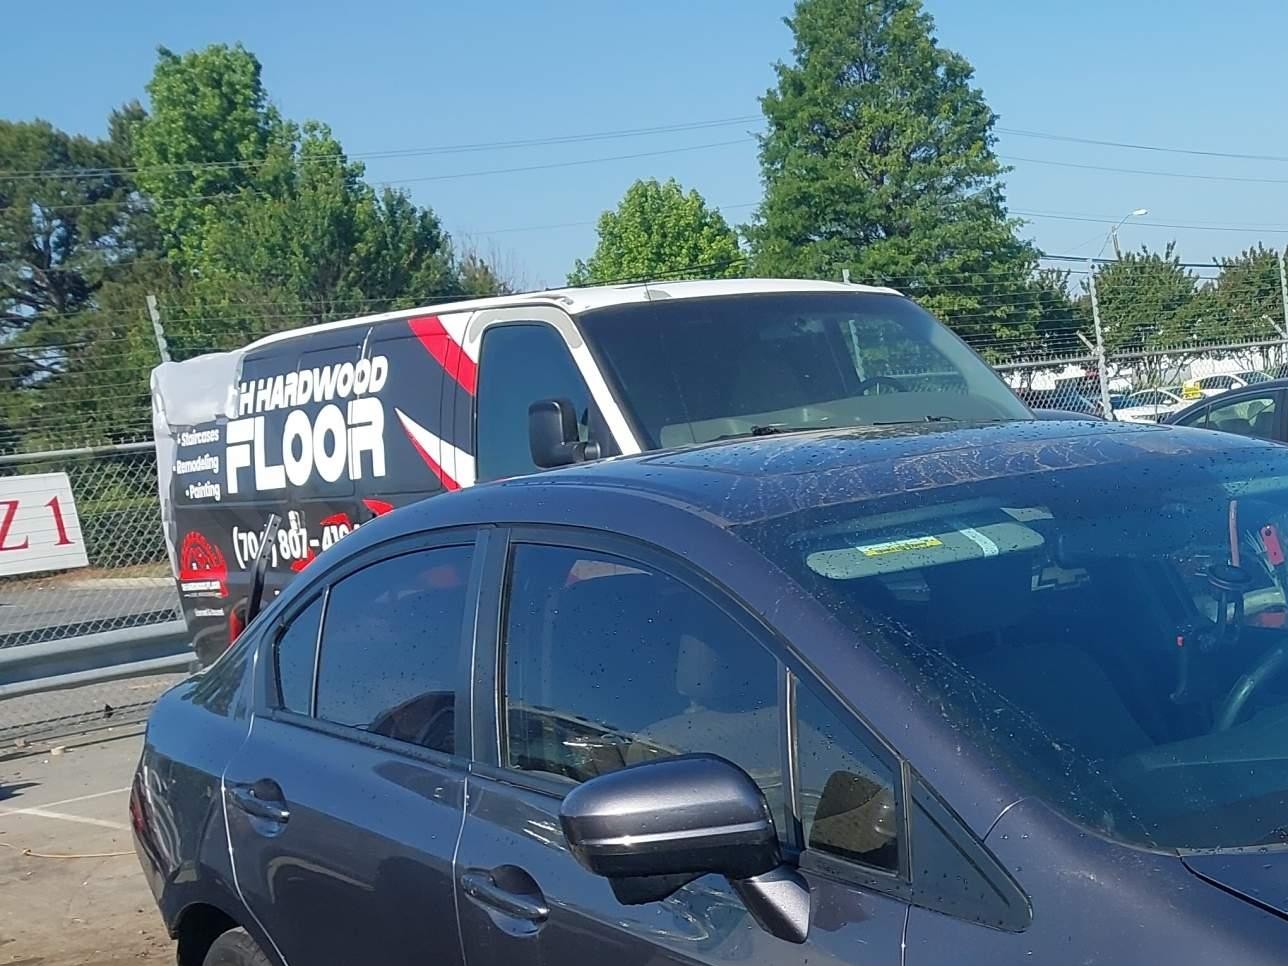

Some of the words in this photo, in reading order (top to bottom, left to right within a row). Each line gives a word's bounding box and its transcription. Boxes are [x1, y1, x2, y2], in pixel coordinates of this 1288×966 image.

[256, 355, 389, 412] HARDWOOD
[181, 429, 219, 447] Staircases
[226, 397, 386, 494] FLOOR
[176, 453, 219, 474] Remodeling
[189, 481, 221, 501] Painting
[233, 526, 278, 569] (70)
